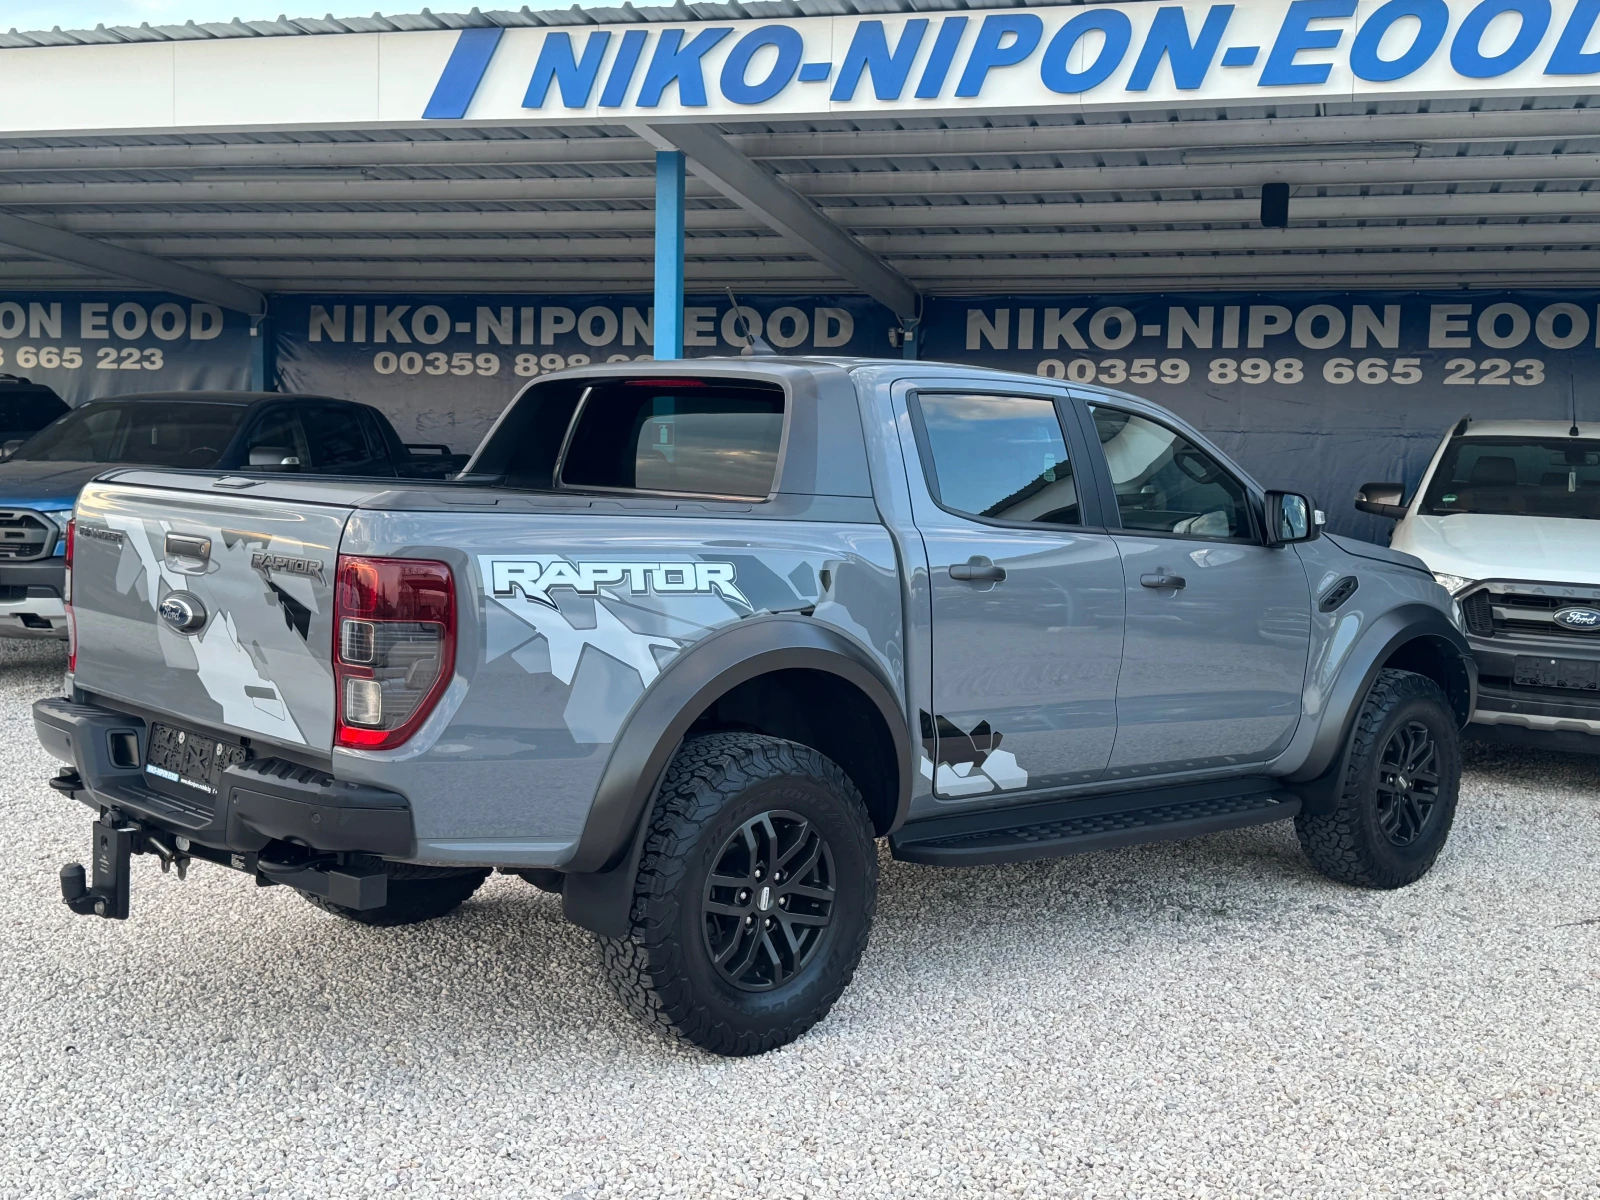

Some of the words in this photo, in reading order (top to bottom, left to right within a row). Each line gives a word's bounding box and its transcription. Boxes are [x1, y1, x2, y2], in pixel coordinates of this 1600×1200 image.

[81, 303, 224, 340] EOOD
[308, 305, 654, 346] NIKO-NIPON
[684, 306, 854, 348] EOOD
[965, 304, 1401, 350] NIKO-NIPON
[1428, 302, 1600, 349] EOO
[16, 346, 83, 369] 665
[96, 347, 164, 370] 223
[373, 352, 500, 375] 00359
[1036, 358, 1191, 385] 00359
[1207, 357, 1304, 385] 898
[1322, 357, 1423, 385] 665
[1443, 357, 1545, 386] 223
[252, 552, 328, 587] RAPTOR
[491, 561, 754, 612] RAPTOR
[1566, 611, 1597, 625] Ford
